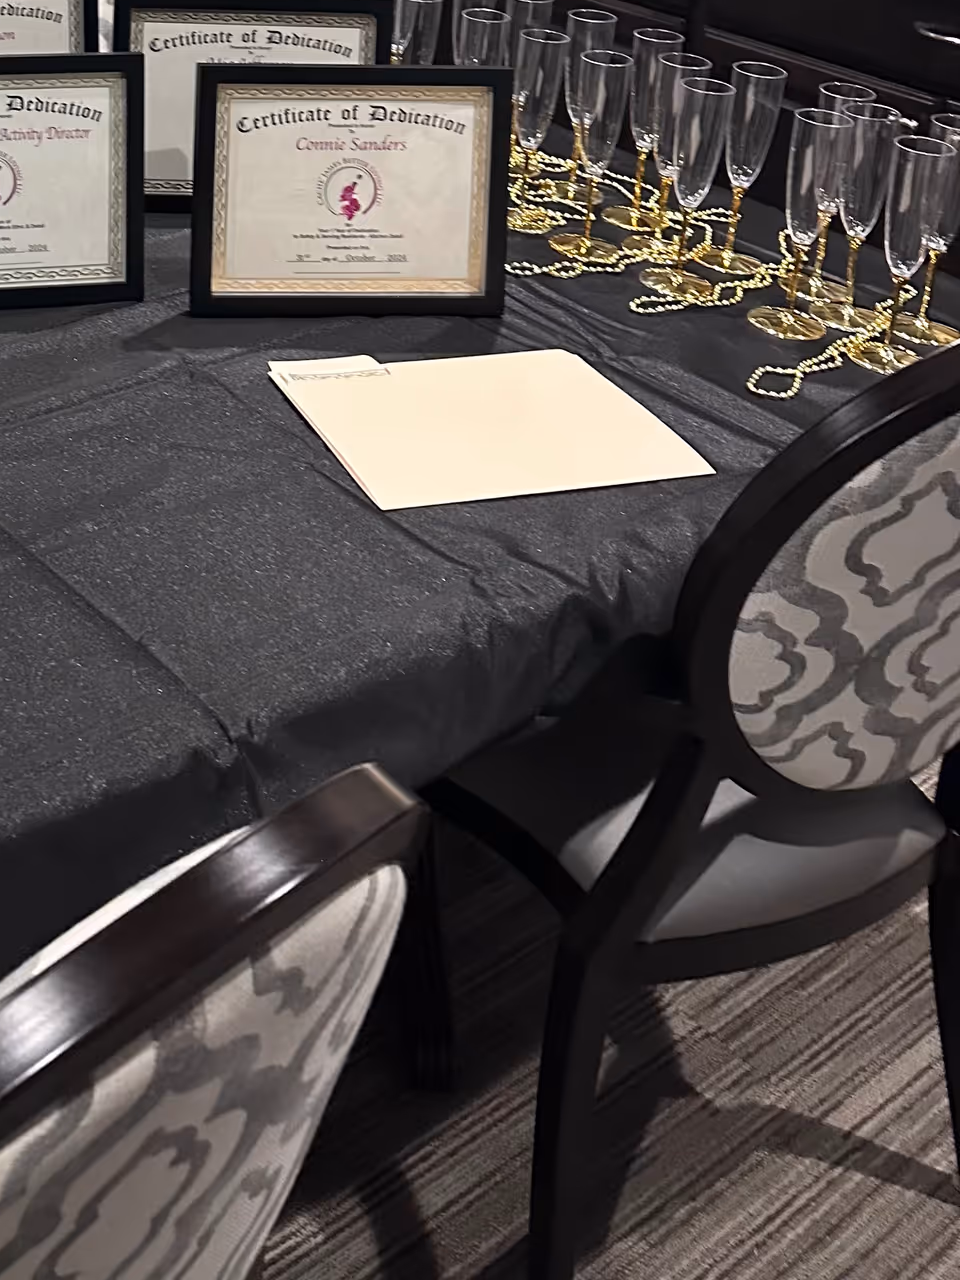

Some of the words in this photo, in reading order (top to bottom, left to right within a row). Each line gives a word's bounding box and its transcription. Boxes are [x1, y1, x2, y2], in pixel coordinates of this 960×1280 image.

[147, 30, 234, 52] Certificate
[241, 29, 258, 43] of
[266, 29, 353, 58] Dedication
[6, 95, 103, 122] Dedication
[236, 106, 332, 133] Certificate
[341, 105, 359, 120] of
[369, 104, 467, 135] Dedication
[0, 128, 42, 147] Activity
[46, 126, 92, 140] Director
[295, 137, 346, 151] Connie
[349, 134, 408, 151] Sanders
